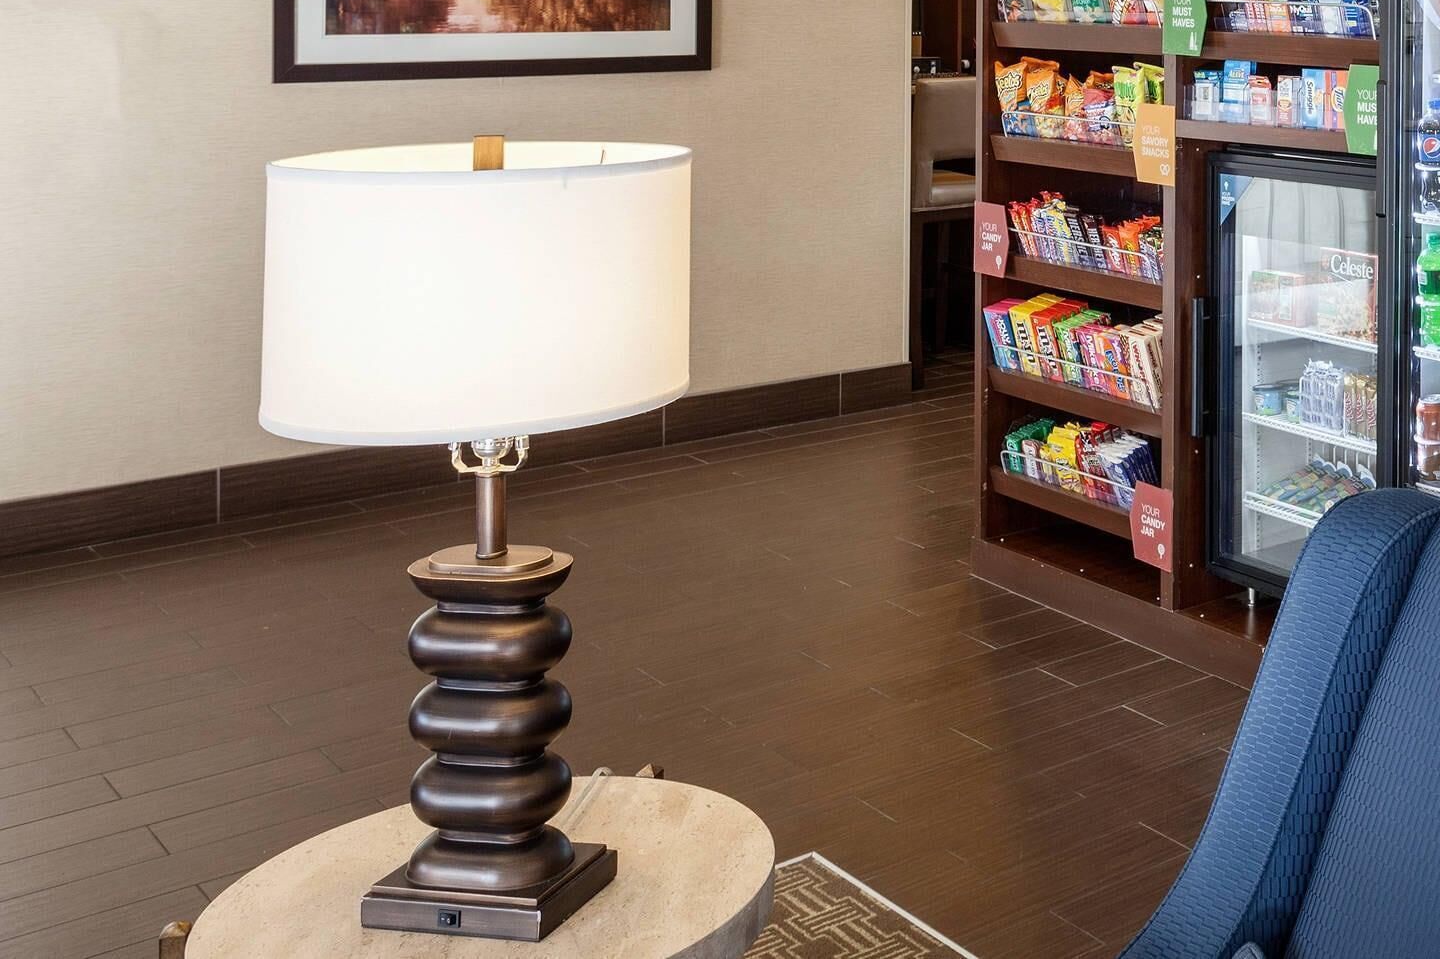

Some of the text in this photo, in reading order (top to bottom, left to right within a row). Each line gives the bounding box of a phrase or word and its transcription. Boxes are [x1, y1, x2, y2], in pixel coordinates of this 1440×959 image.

[1172, 7, 1193, 16] MUST
[1172, 18, 1195, 28] HAVES
[1357, 102, 1377, 113] MUS
[1357, 114, 1377, 125] HAVE
[1141, 125, 1161, 134] YOUR
[1141, 136, 1168, 147] SAVORY
[1141, 147, 1169, 158] SNACKS
[981, 222, 998, 231] YOUR
[981, 232, 1002, 242] CANDY
[981, 242, 993, 251] JAR
[1330, 254, 1373, 280] Celeste
[999, 319, 1011, 345] JOLLY
[1141, 503, 1160, 516] YOUR
[1141, 515, 1166, 530] CANDY
[1140, 526, 1155, 538] JAR
